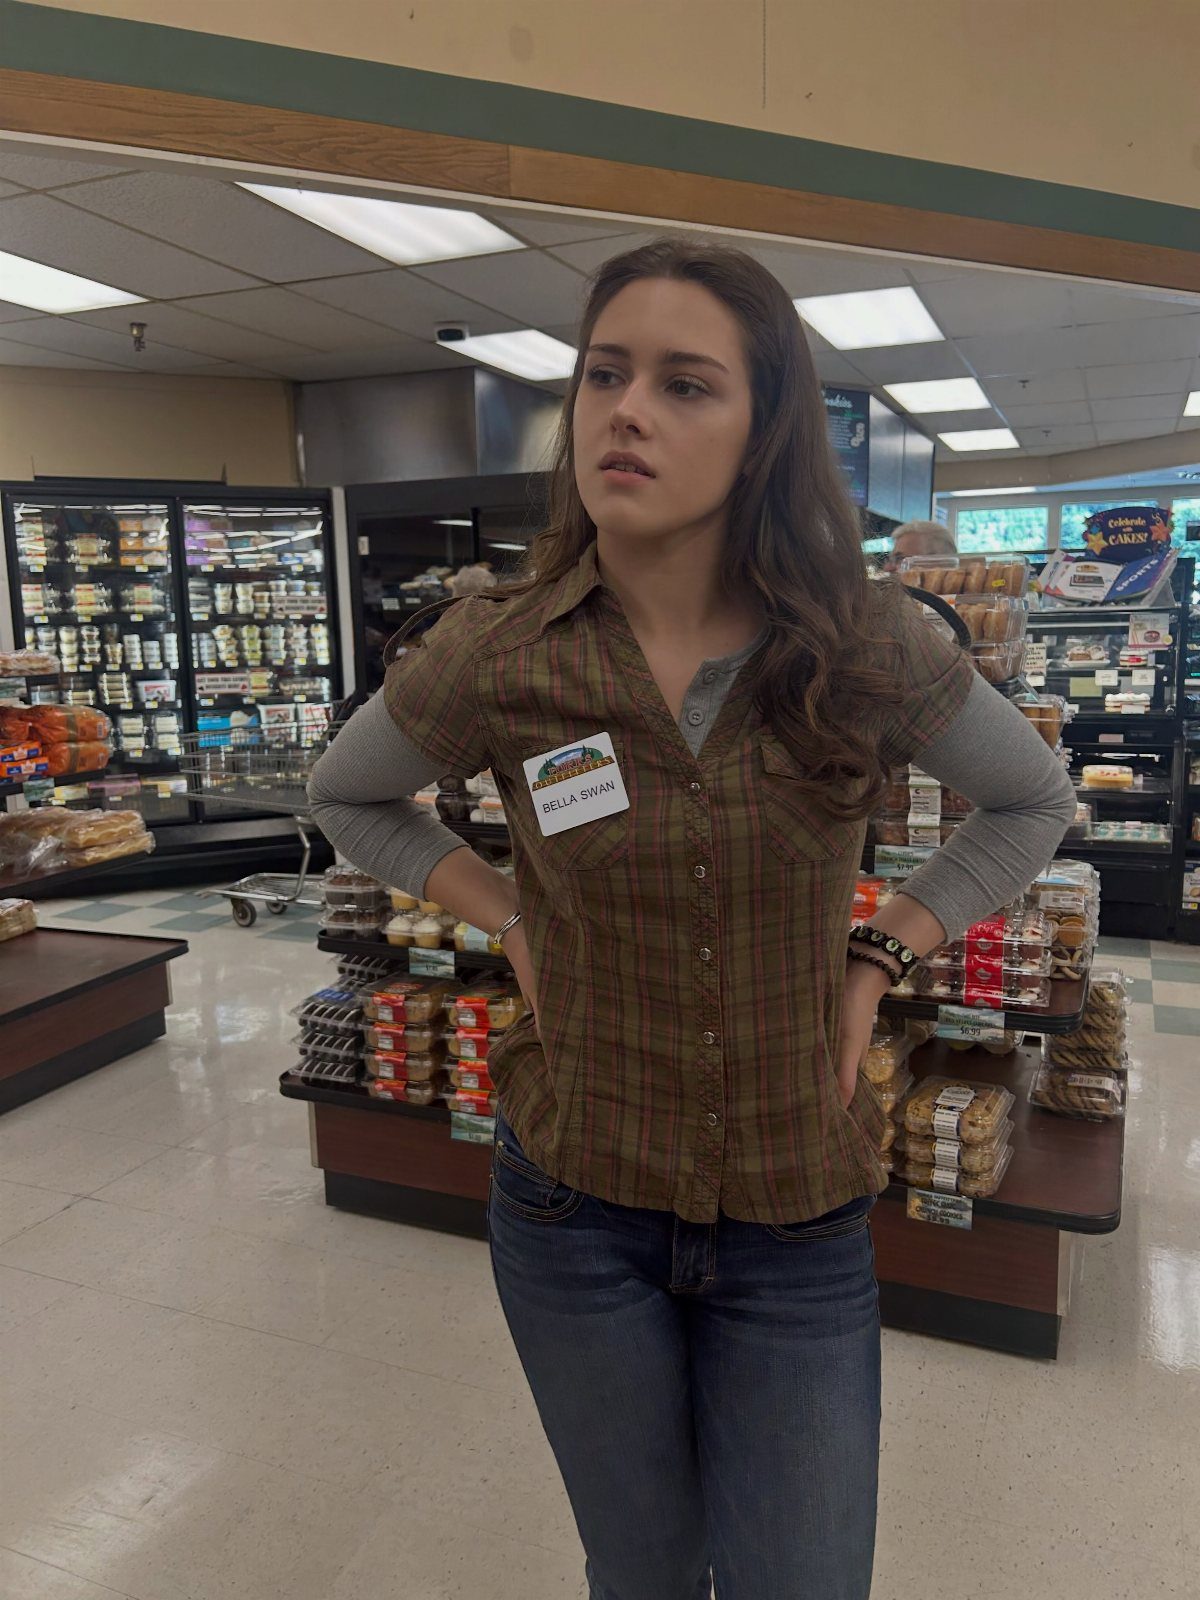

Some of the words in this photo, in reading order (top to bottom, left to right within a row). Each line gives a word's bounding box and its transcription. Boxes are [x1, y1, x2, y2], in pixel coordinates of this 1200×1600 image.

[1108, 517, 1146, 528] Celebrate
[1108, 533, 1148, 546] CAKES!
[1116, 558, 1158, 592] SPORTS
[542, 794, 578, 814] BELLA
[580, 780, 615, 800] SWAN
[960, 1025, 981, 1036] $6.99
